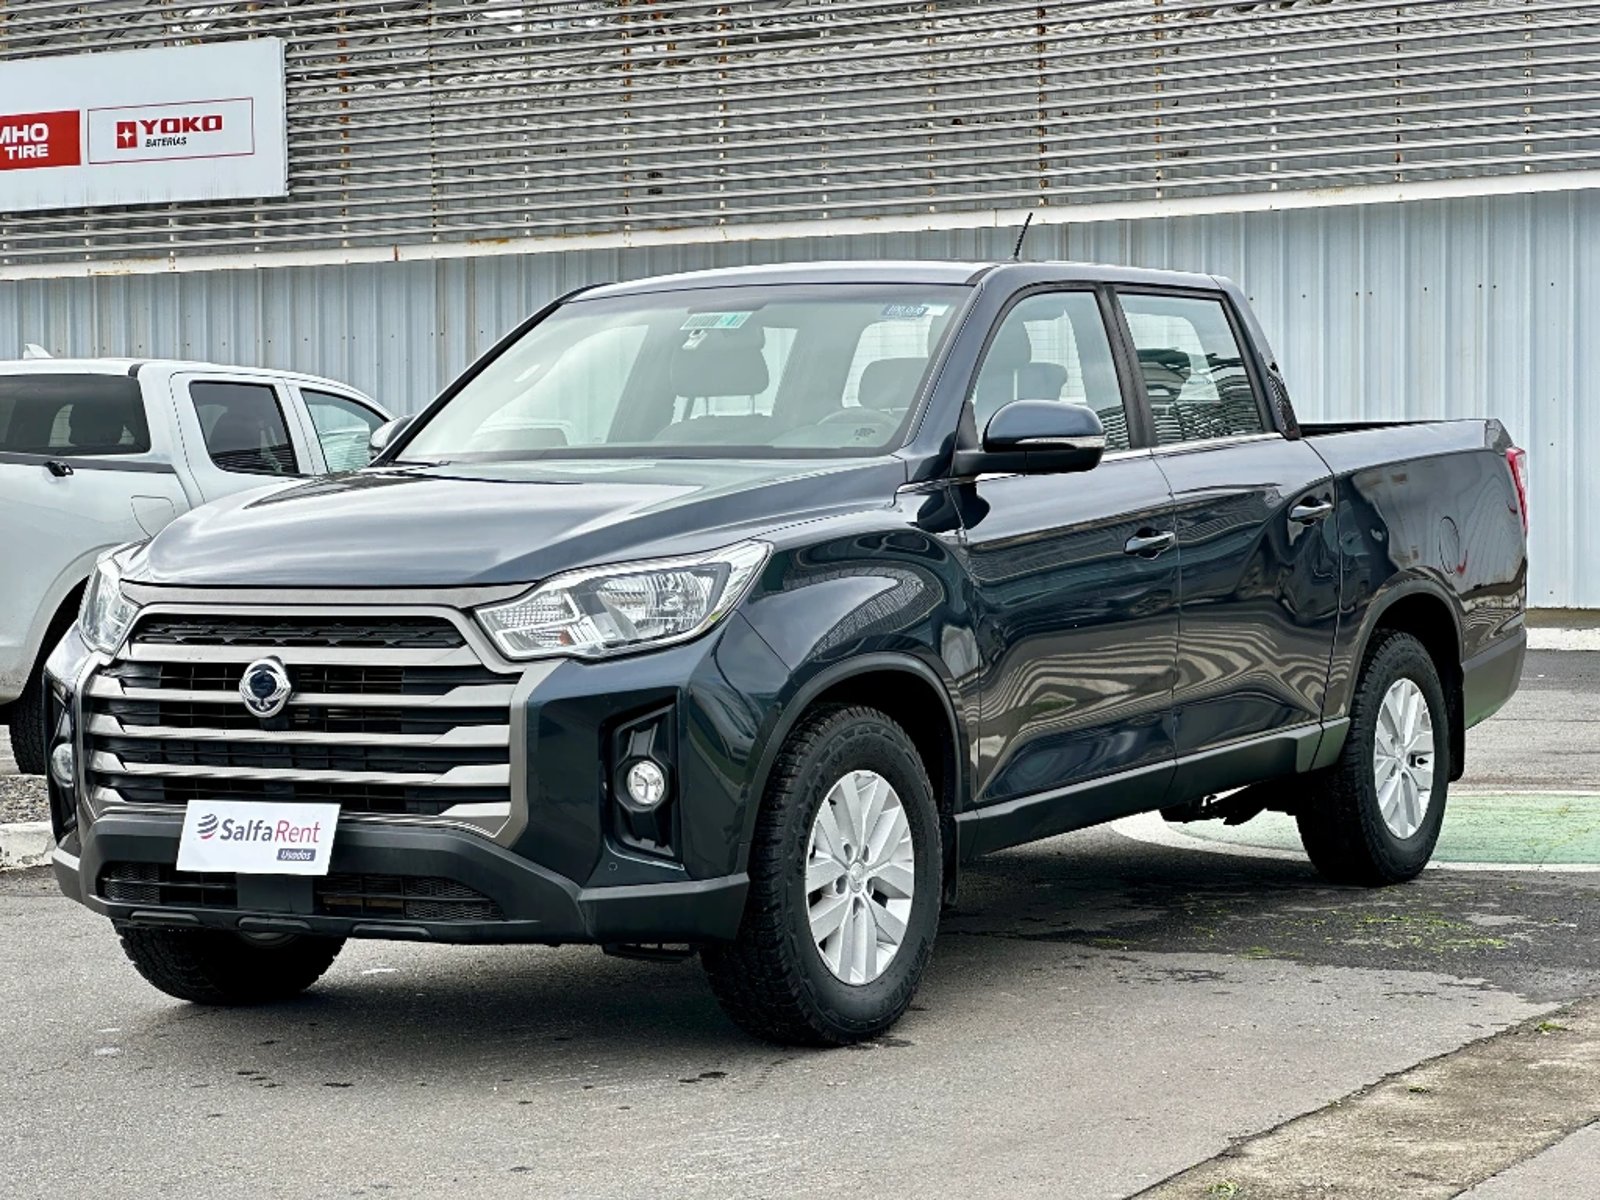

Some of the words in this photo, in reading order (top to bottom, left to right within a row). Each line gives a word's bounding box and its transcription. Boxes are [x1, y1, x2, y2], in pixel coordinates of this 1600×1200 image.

[139, 115, 223, 135] YOKO
[4, 143, 49, 160] TIRE
[220, 818, 321, 843] SalfaRent
[280, 849, 312, 860] Usados
